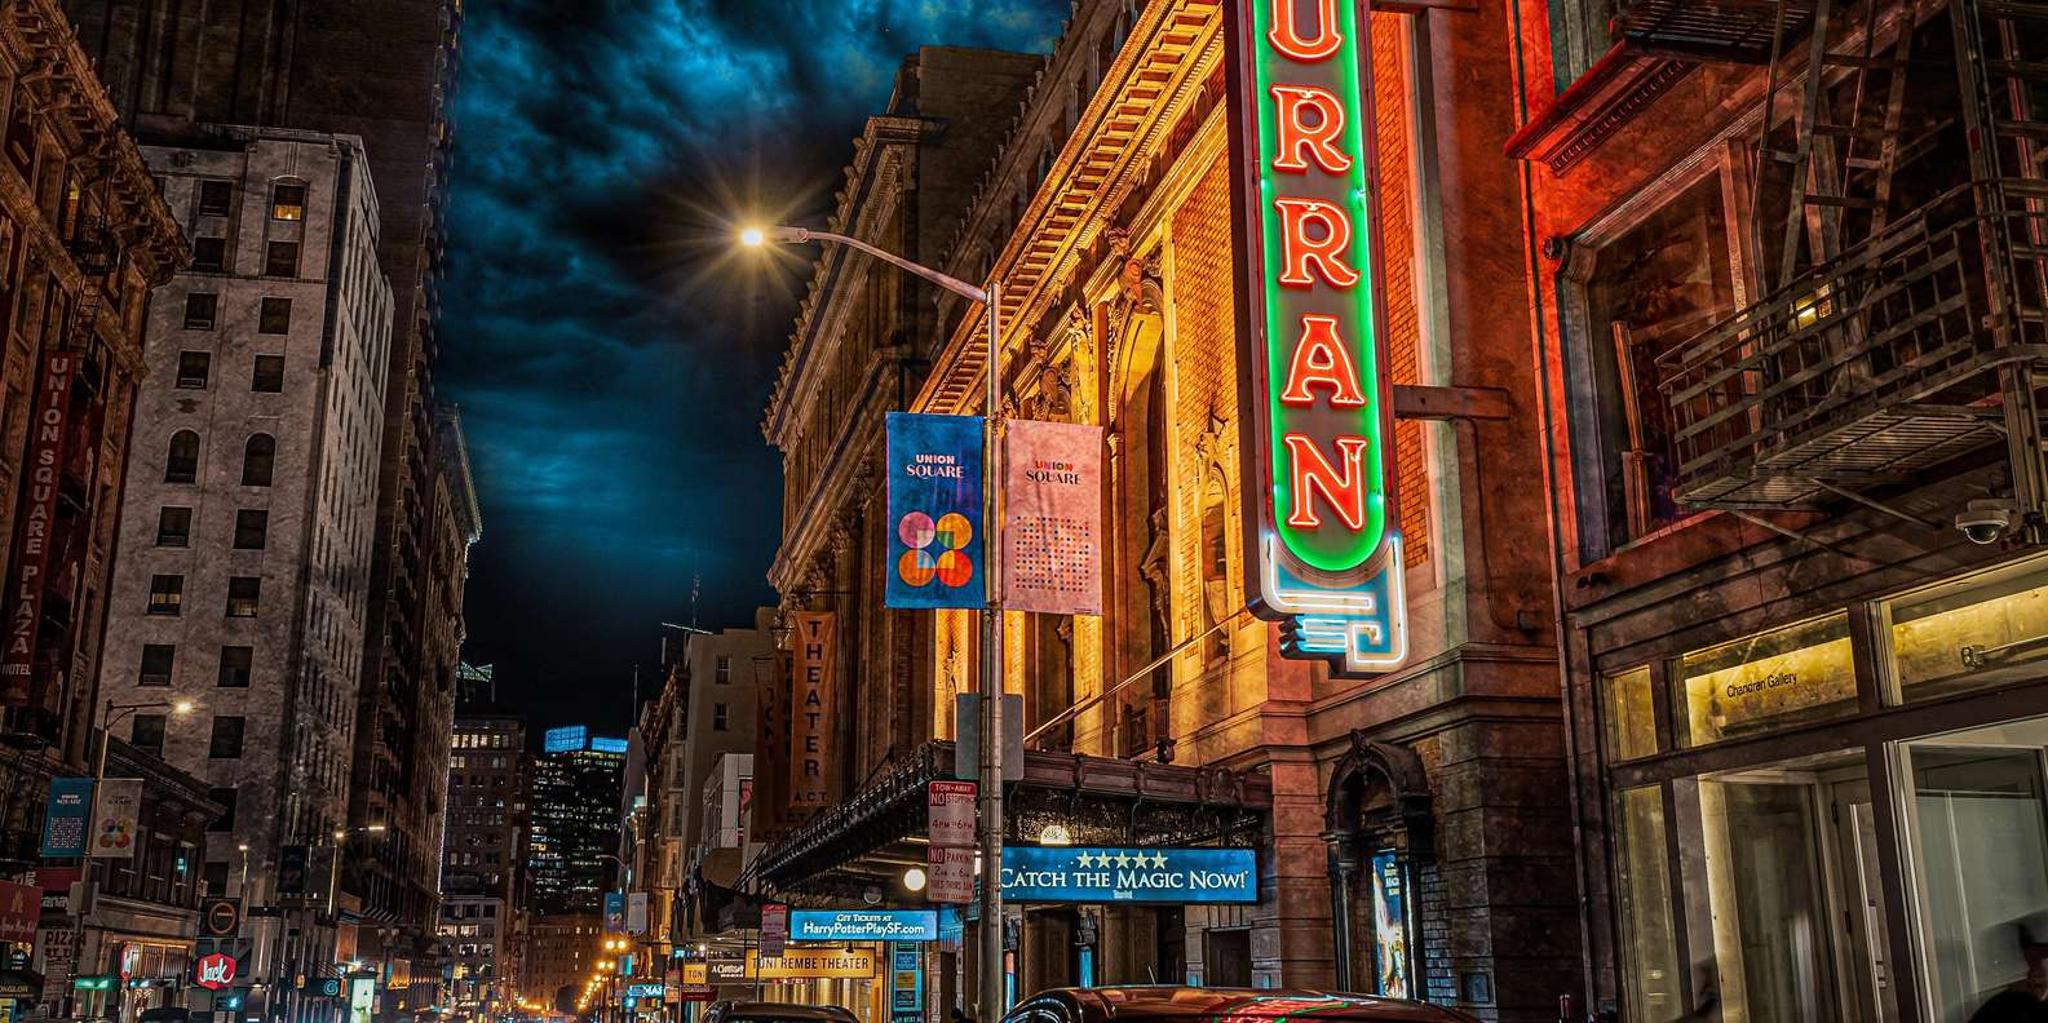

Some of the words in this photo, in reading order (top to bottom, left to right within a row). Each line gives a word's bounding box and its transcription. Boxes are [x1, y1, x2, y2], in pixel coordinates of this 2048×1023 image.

[1267, 0, 1368, 531] URRAN
[41, 357, 69, 443] UNION
[915, 454, 955, 465] UNION
[1035, 460, 1073, 472] UNION
[906, 465, 965, 480] SQUARE
[1025, 470, 1081, 486] SQUARE
[25, 449, 55, 556] SQUARE
[9, 566, 39, 654] PLAZA
[1, 663, 32, 676] HOTEL
[1728, 678, 1766, 698] Chandran
[1767, 671, 1798, 692] Gallery
[803, 620, 823, 777] THEATER
[930, 793, 945, 806] NO
[930, 848, 944, 863] NO
[1001, 868, 1066, 888] CATCH
[1073, 872, 1110, 888] THE
[1117, 870, 1183, 889] MAGIC
[1190, 870, 1246, 889] NOW!
[803, 923, 925, 938] HarryPotterPlaySF.com
[200, 957, 233, 984] Jack
[781, 957, 817, 969] REMBE
[821, 957, 869, 969] THEATER
